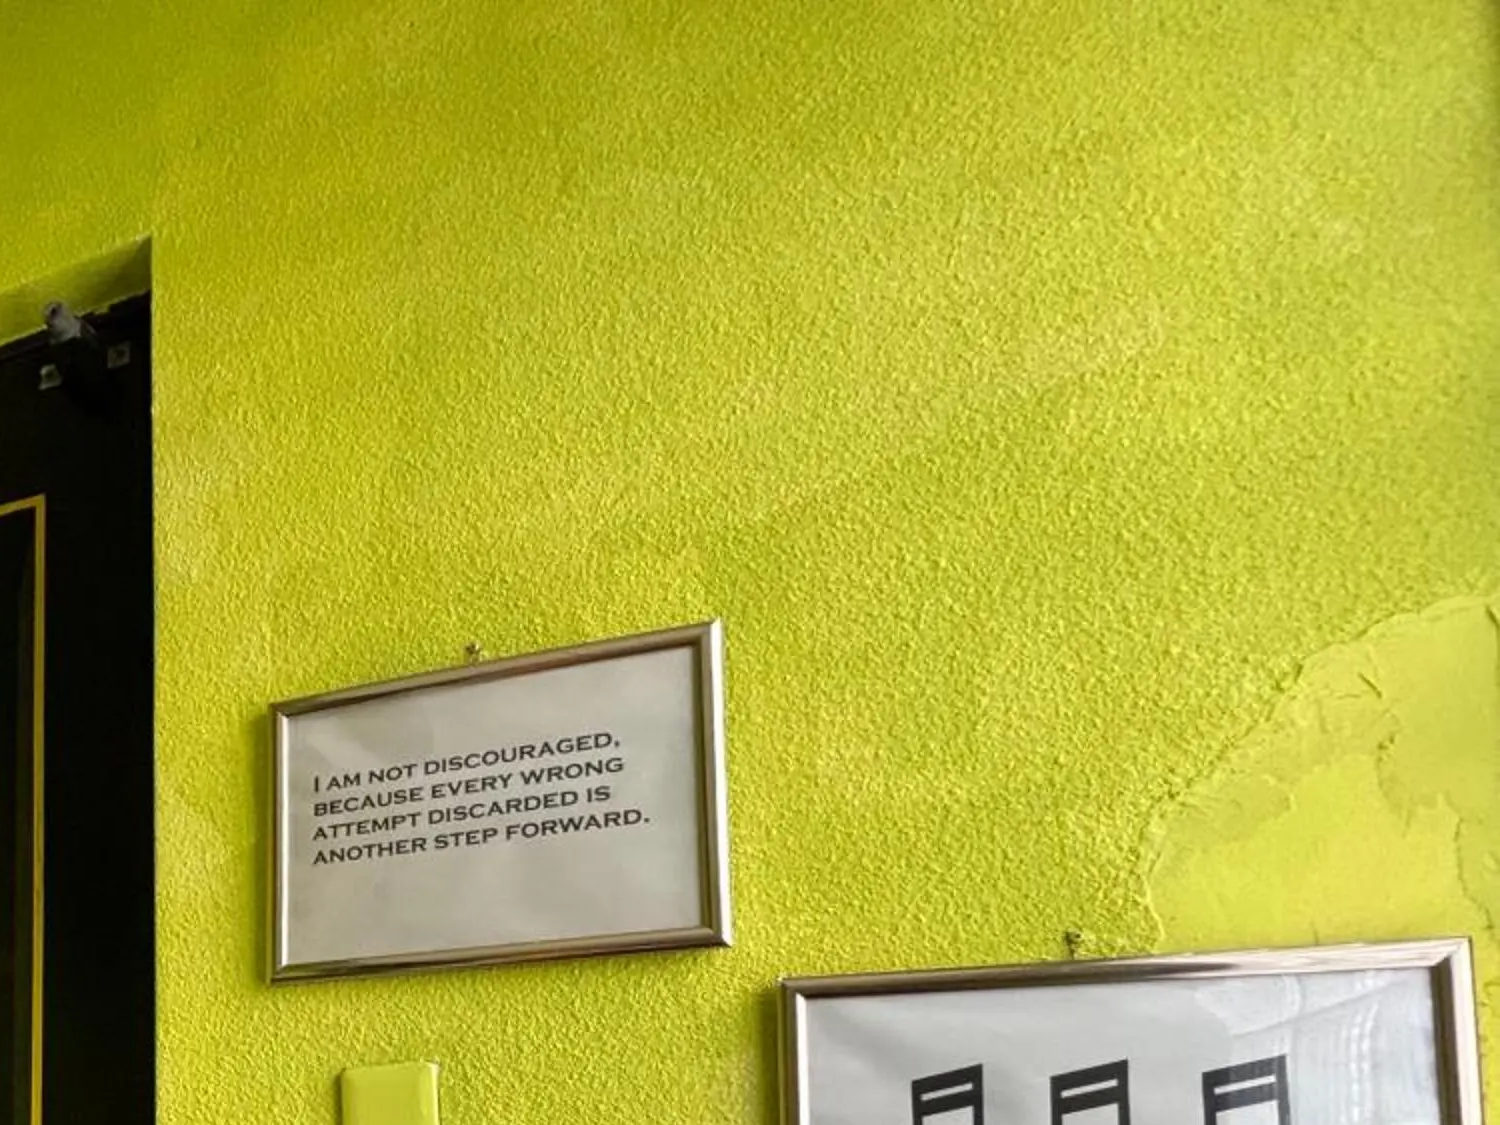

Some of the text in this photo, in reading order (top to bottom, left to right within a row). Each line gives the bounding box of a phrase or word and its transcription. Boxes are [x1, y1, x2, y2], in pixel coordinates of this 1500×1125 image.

[313, 732, 621, 793] I AM NOT DISCOURAGED,
[313, 757, 625, 817] BECAUSE EVERY WRONG
[312, 785, 611, 840] ATTEMPT DISCARDED IS
[312, 808, 651, 865] ANOTHER STEP FORWARD.
